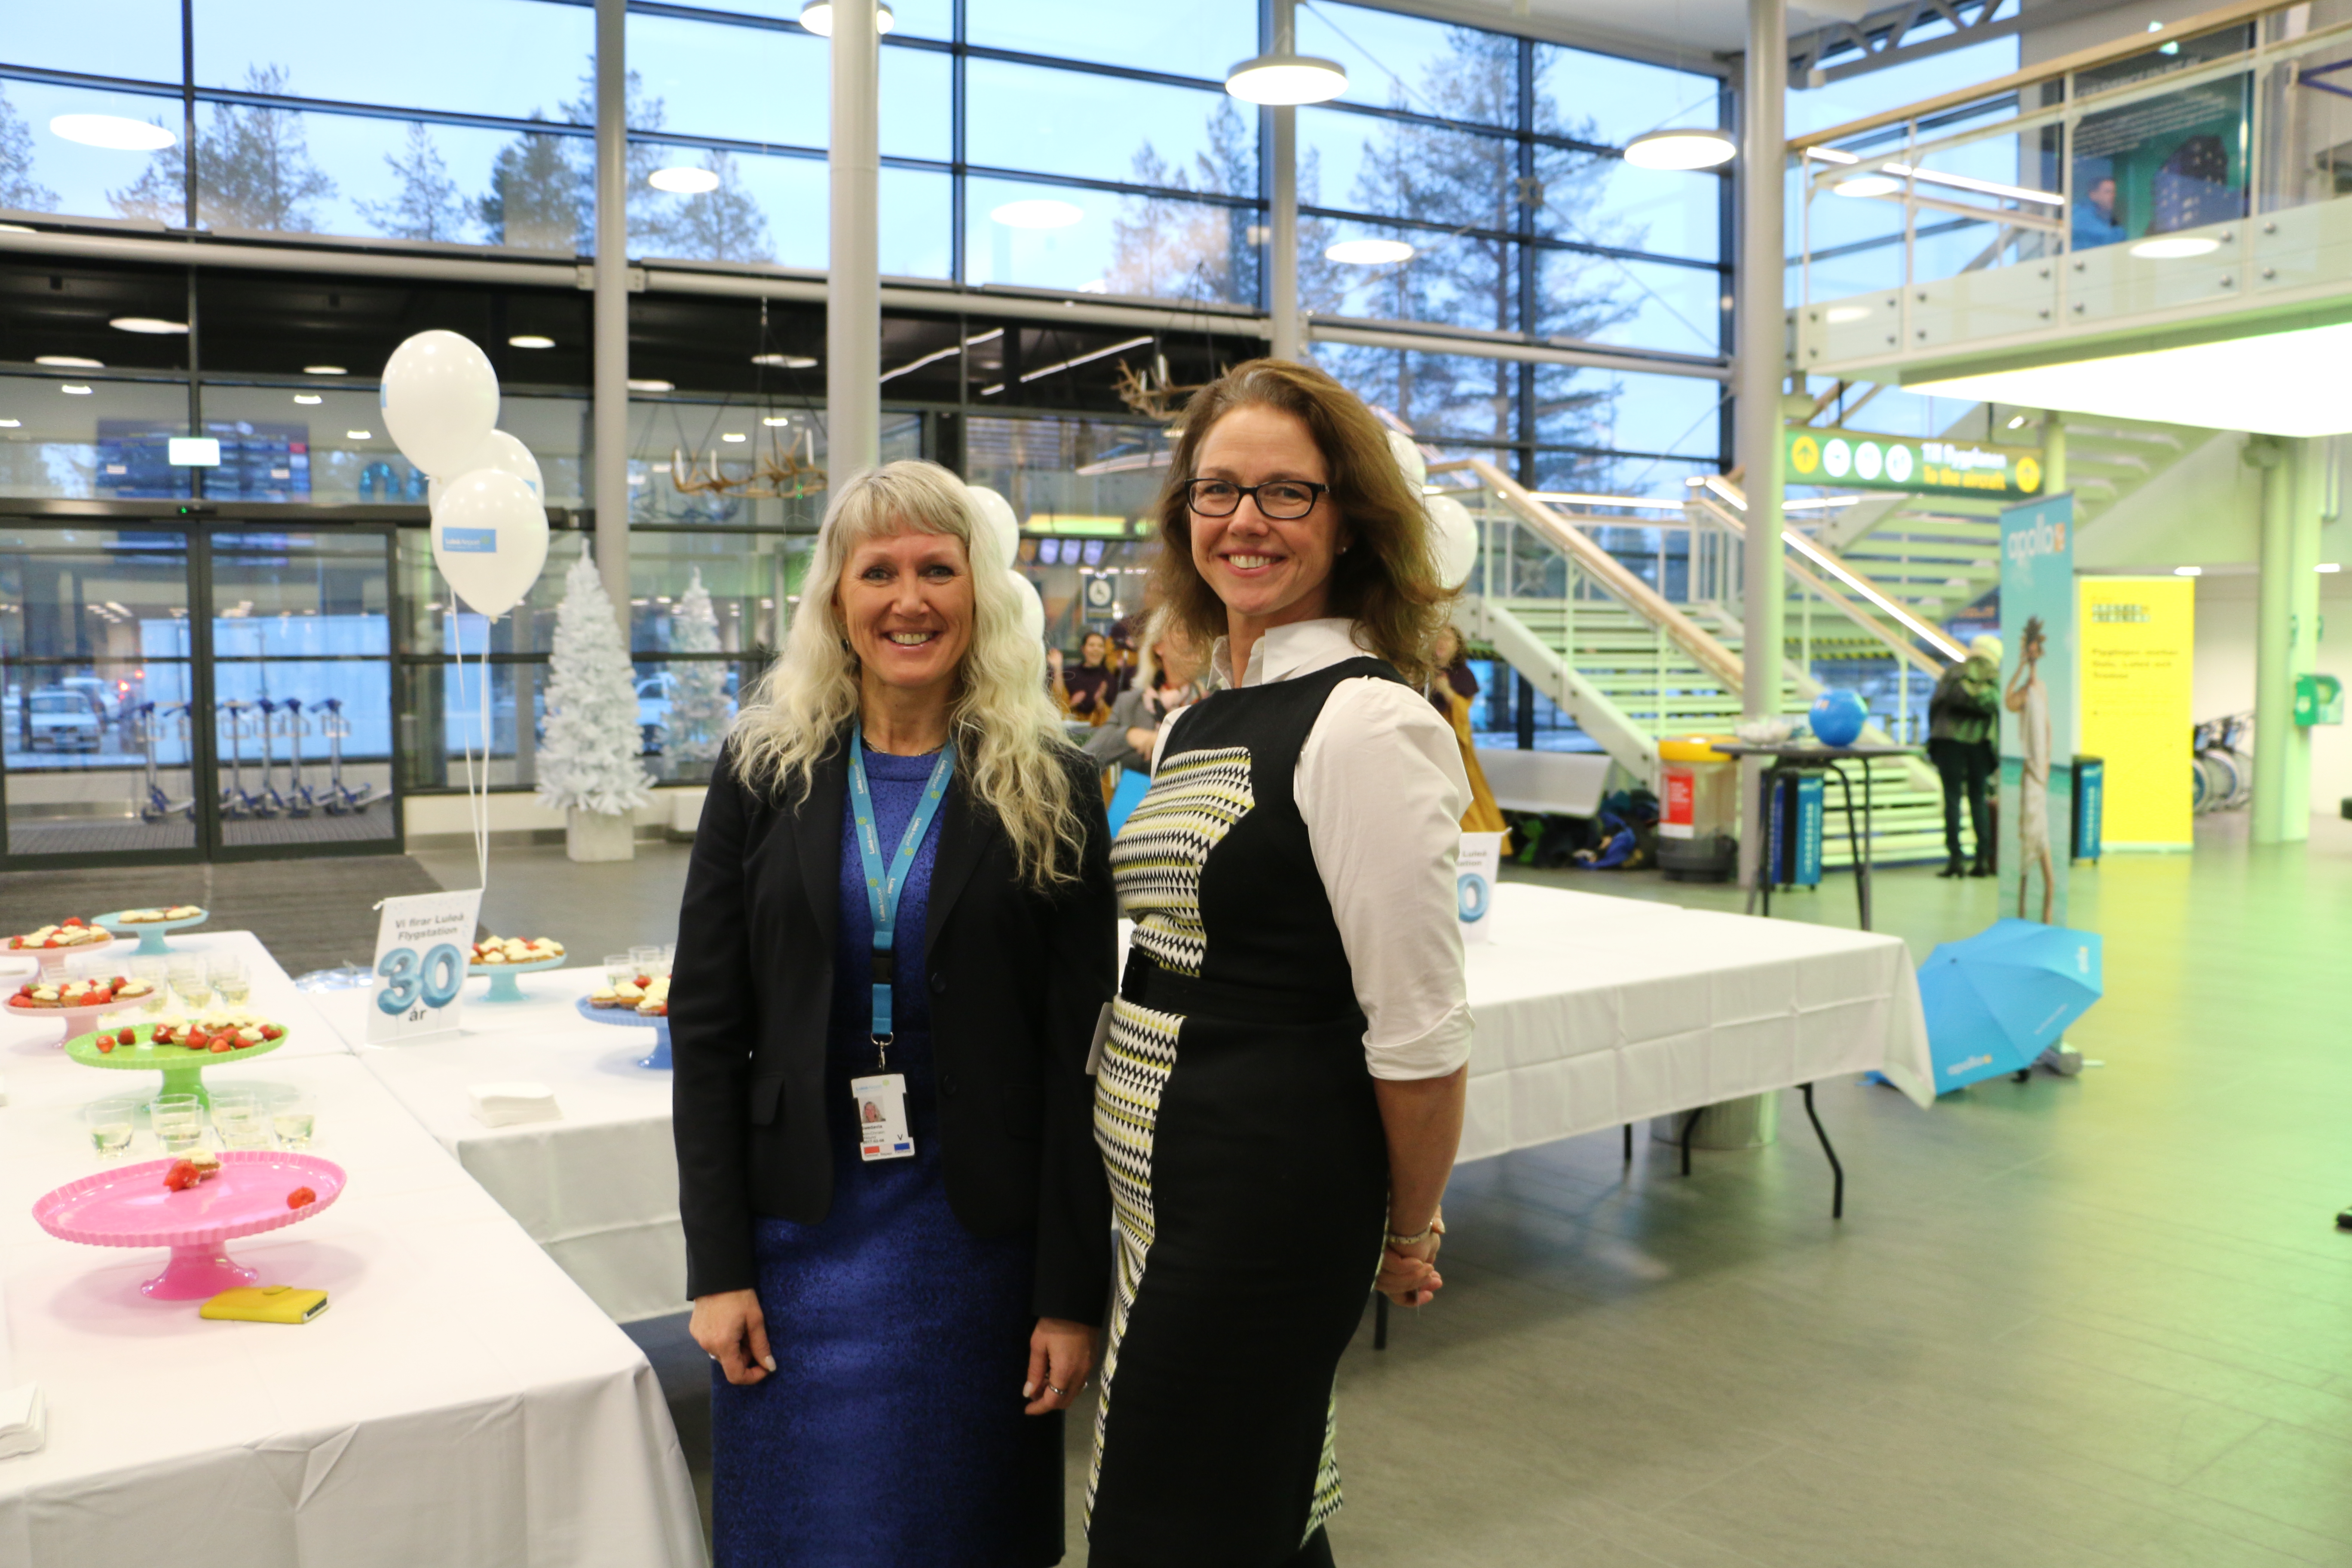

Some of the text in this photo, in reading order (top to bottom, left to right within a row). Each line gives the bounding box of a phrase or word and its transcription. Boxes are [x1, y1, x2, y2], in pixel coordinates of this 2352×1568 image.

[395, 913, 464, 928] Vi firar Luleå
[398, 927, 458, 941] Flygstation
[377, 943, 463, 1016] 30
[409, 1008, 426, 1022] år
